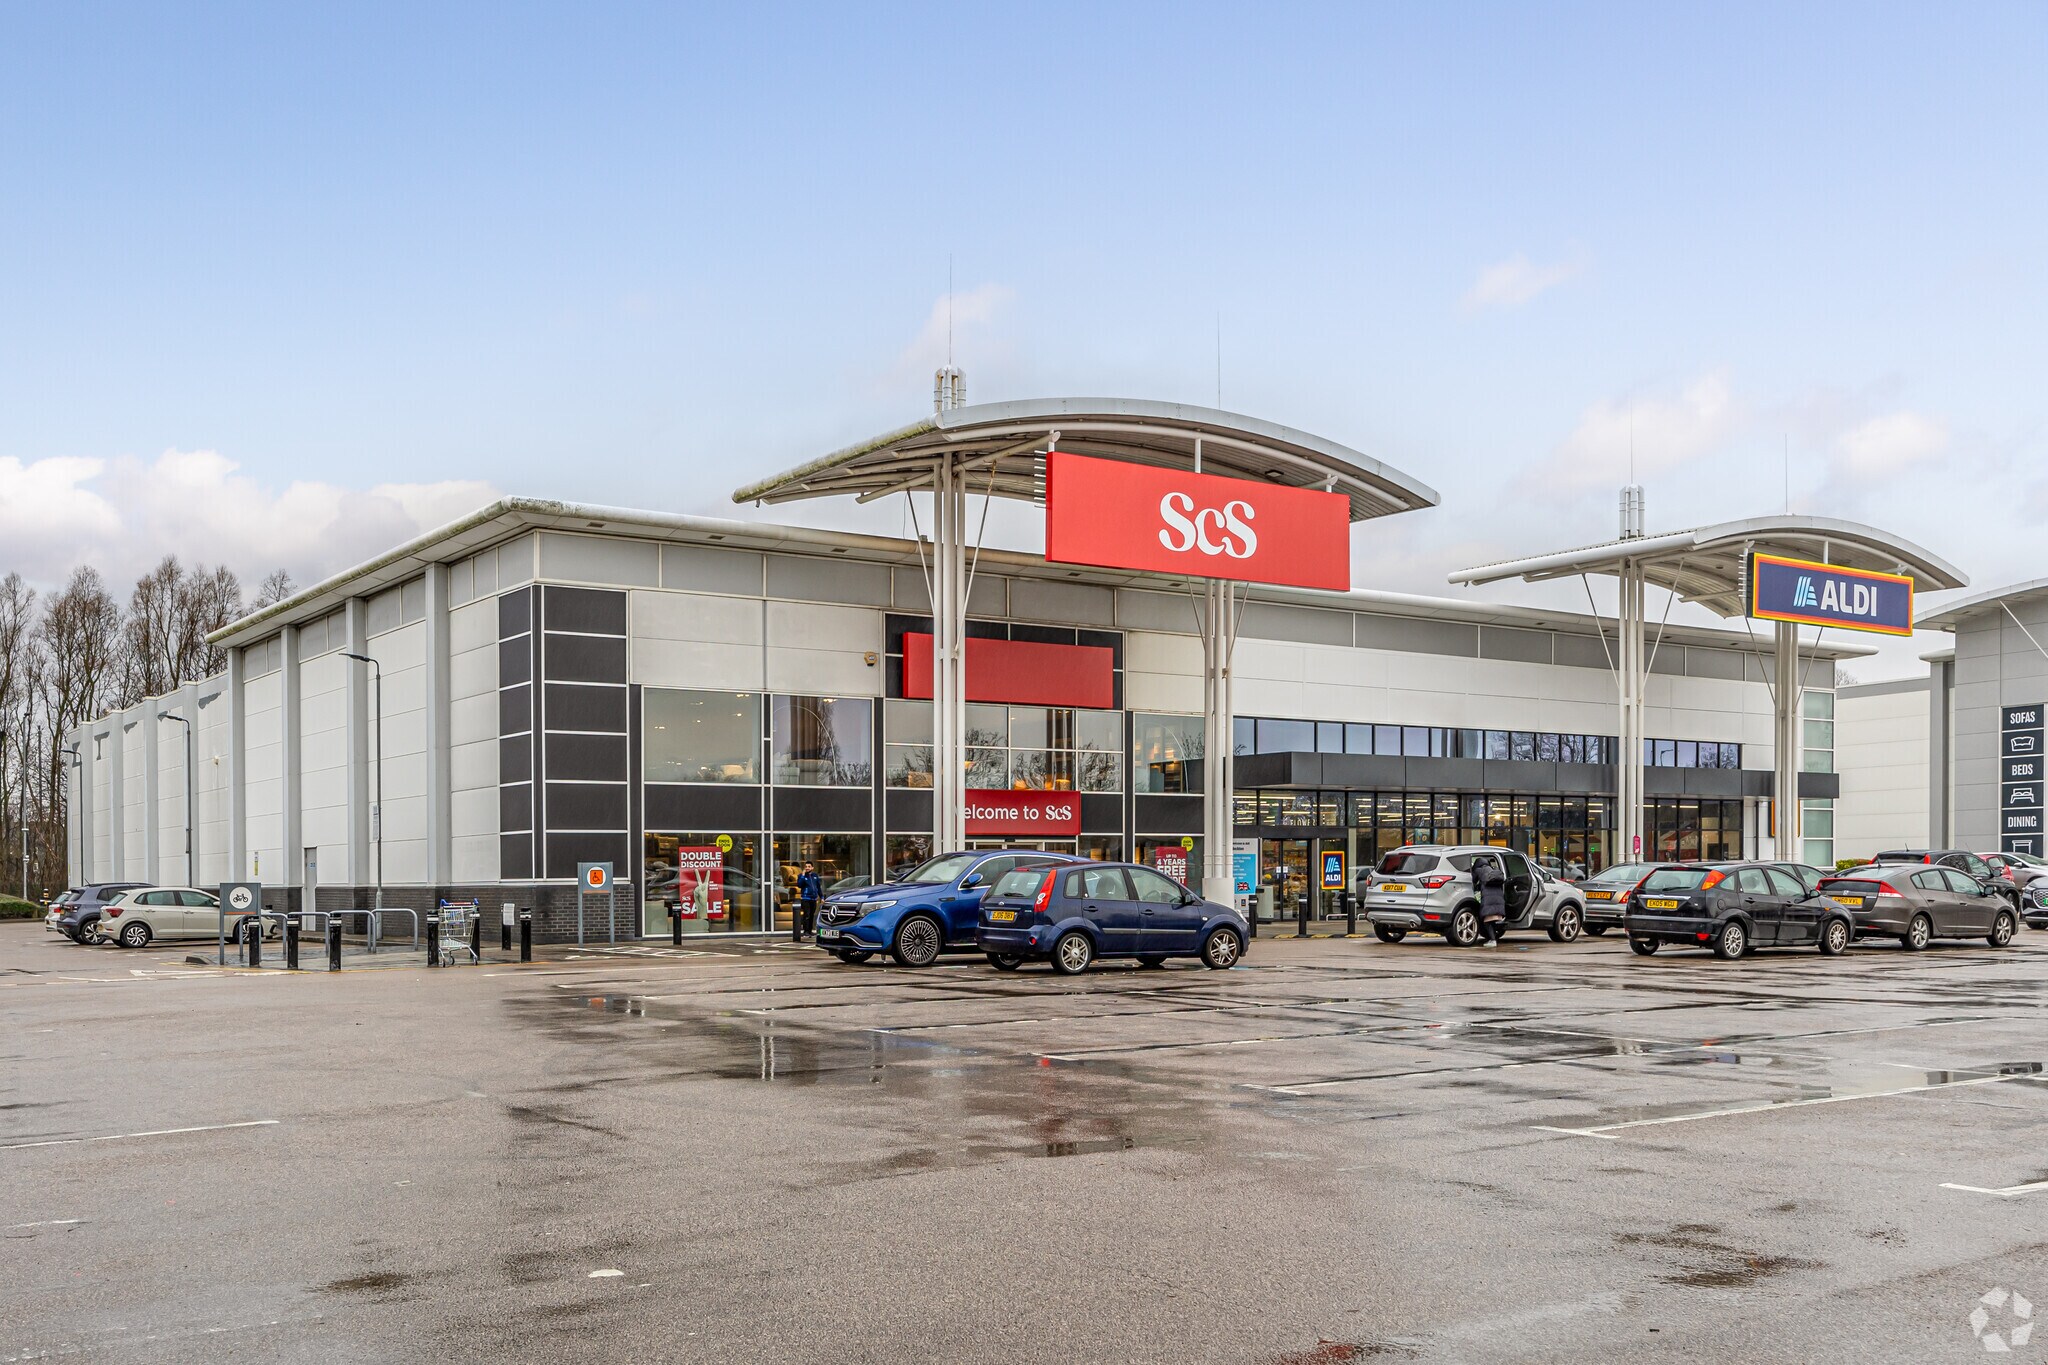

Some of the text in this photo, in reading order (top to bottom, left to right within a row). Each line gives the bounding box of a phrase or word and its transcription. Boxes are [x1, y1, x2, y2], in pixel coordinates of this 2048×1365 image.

[1158, 492, 1258, 559] ScS
[1820, 580, 1878, 617] ALDI
[2010, 711, 2036, 724] SOFAS
[2011, 764, 2033, 776] BEDS
[965, 804, 1072, 821] elcome to ScS
[2007, 816, 2037, 828] DINING
[680, 852, 721, 860] DOUBLE
[1157, 866, 1186, 876] FREE
